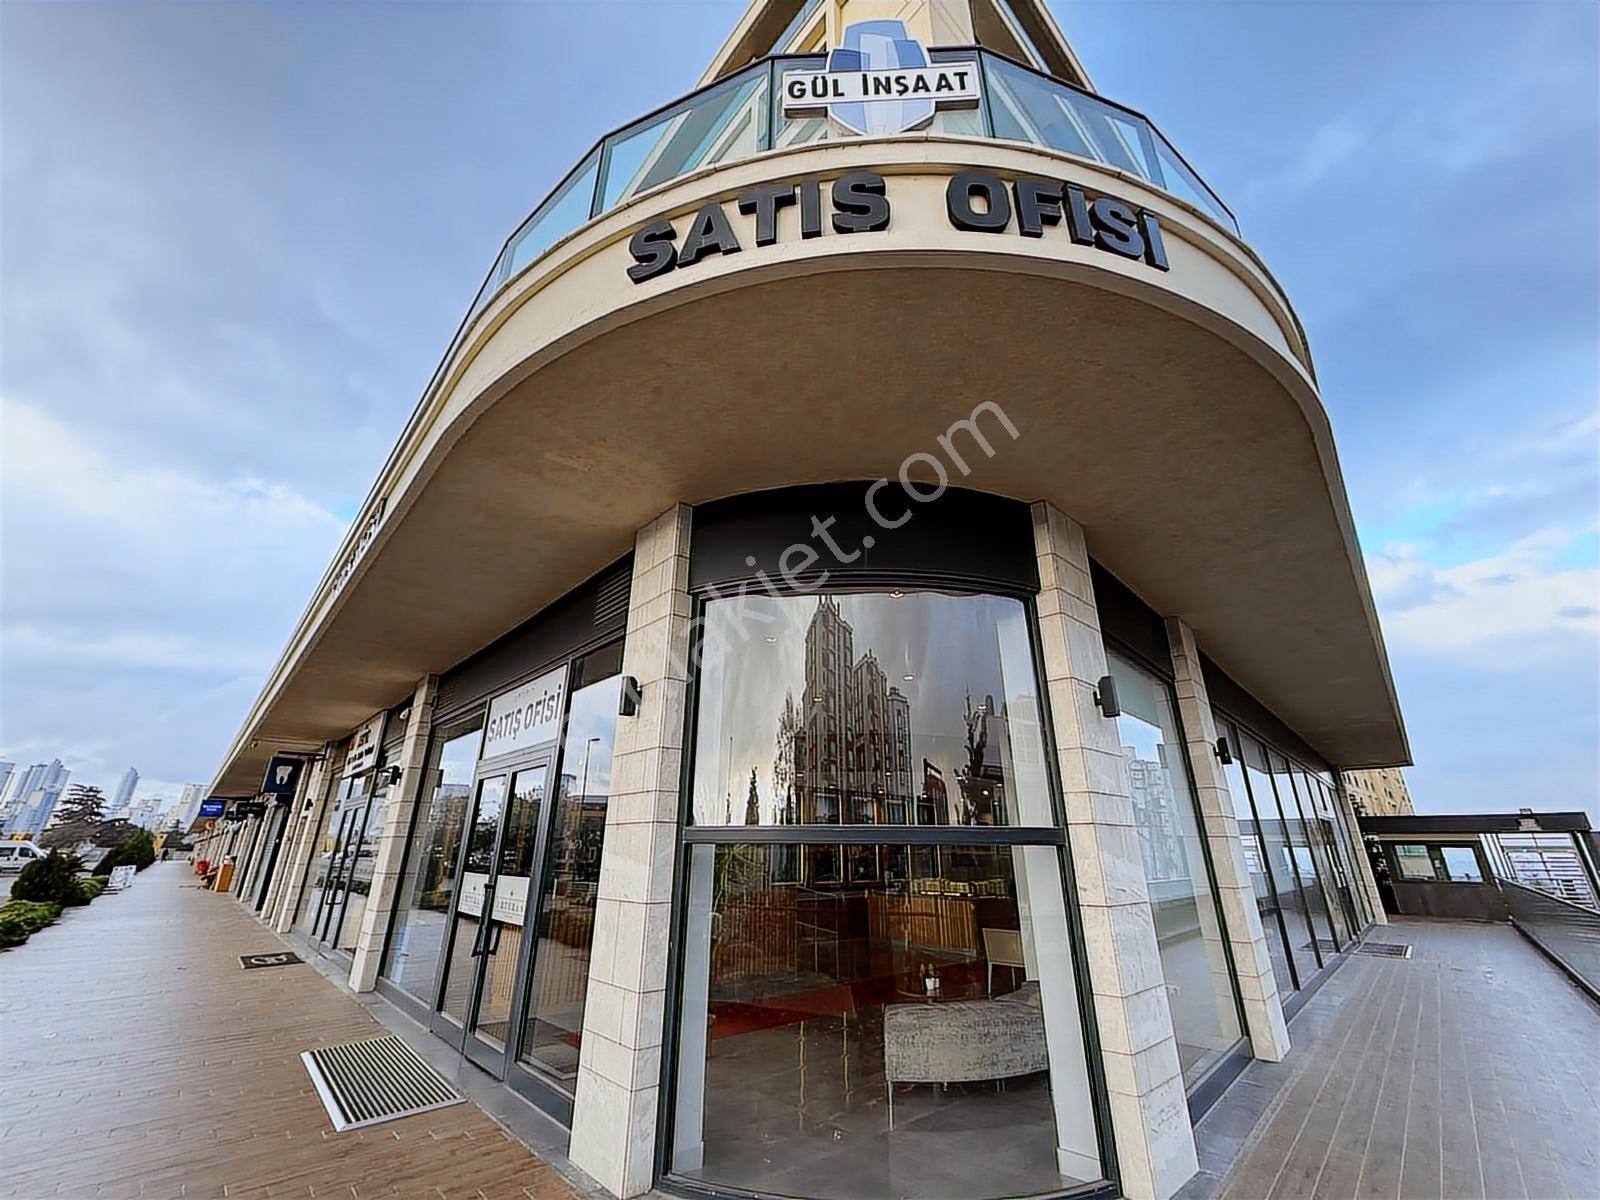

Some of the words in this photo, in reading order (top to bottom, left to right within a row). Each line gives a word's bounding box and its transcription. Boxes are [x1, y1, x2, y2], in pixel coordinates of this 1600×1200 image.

[788, 76, 845, 100] GÜL
[861, 72, 969, 97] İNŞAAT
[488, 709, 522, 743] SATIŞ
[524, 684, 562, 730] OFİSİ
